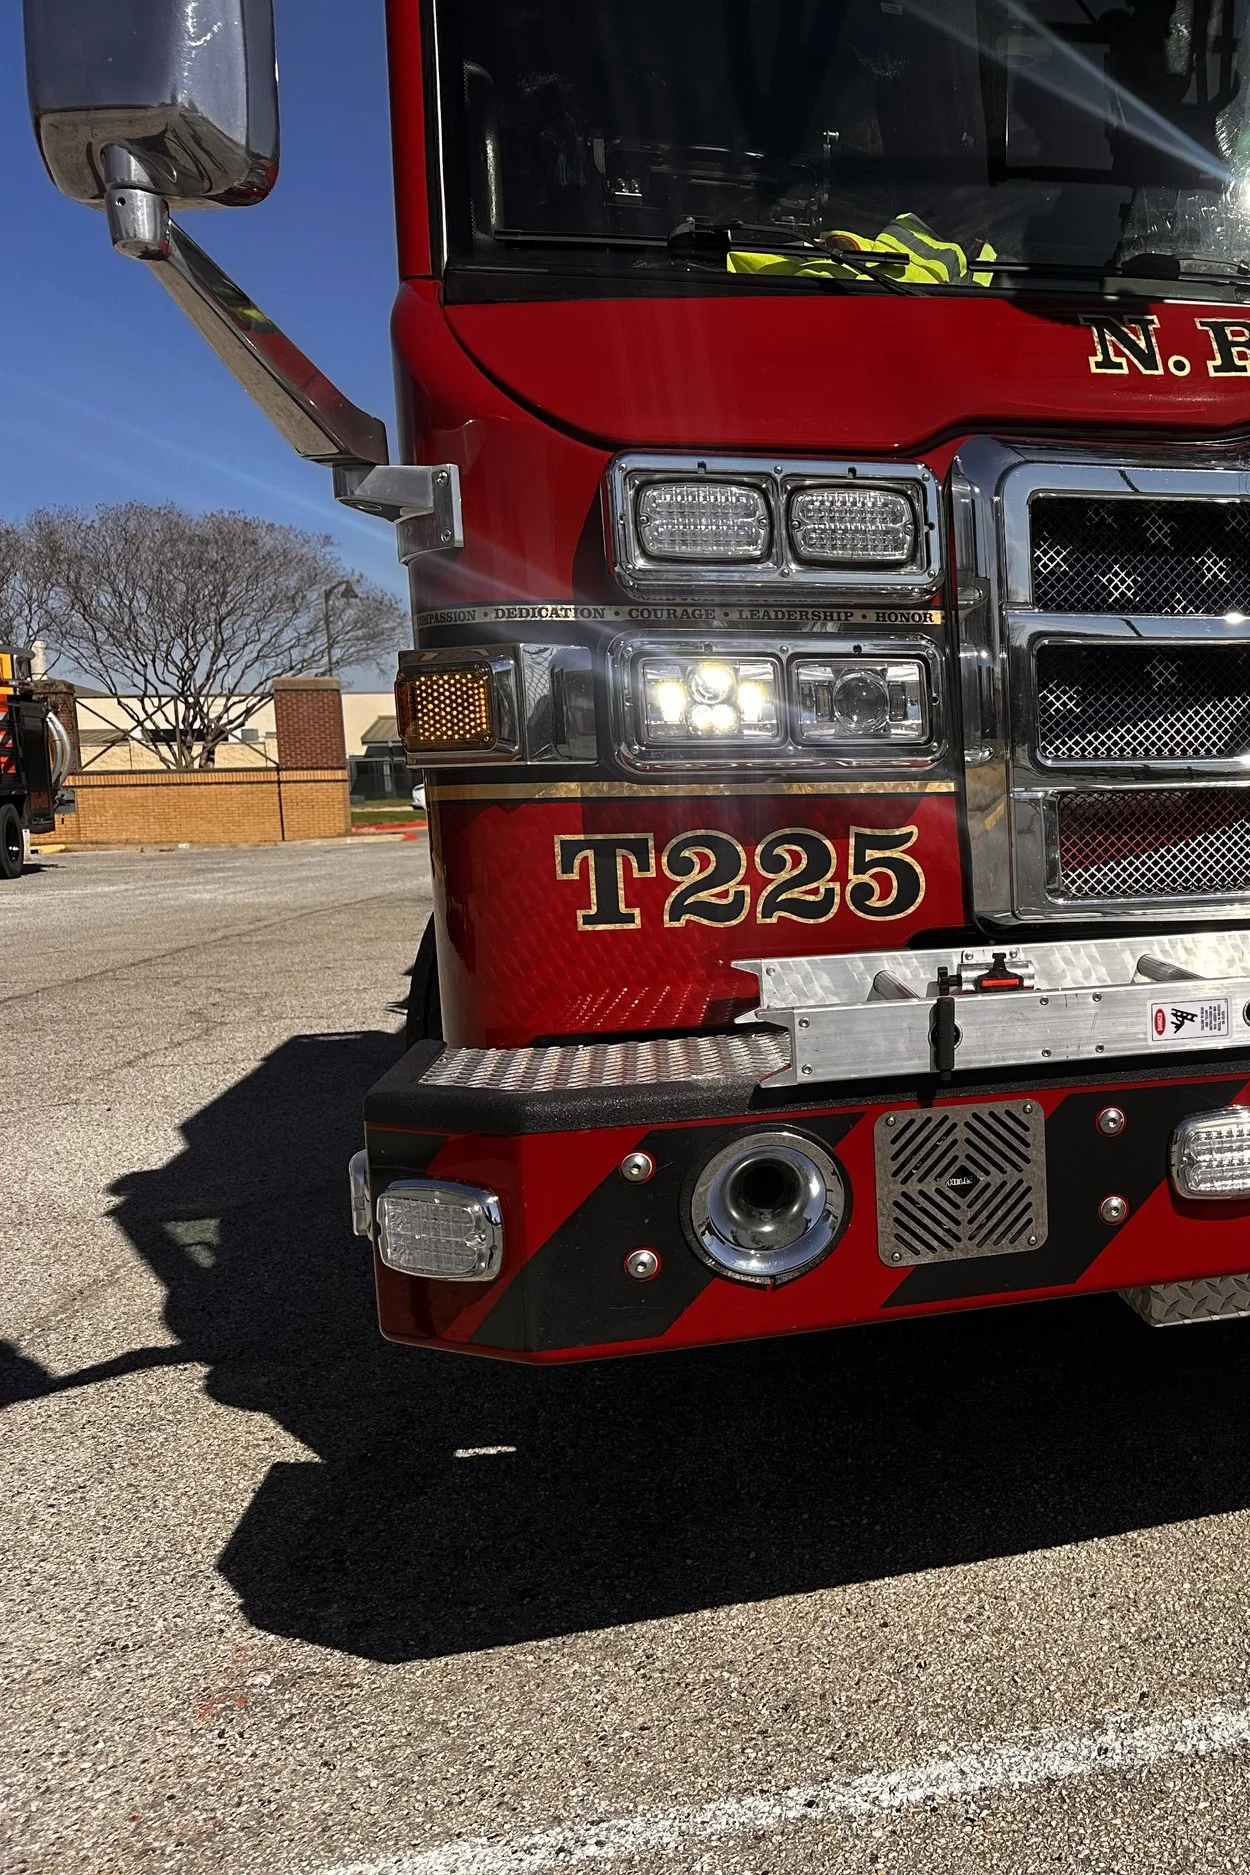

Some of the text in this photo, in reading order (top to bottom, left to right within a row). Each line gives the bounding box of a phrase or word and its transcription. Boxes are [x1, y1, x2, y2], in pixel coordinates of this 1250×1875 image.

[416, 606, 935, 627] COMPASSION DEDICATION COURAGE LEADERSHIP HONOR
[554, 824, 926, 931] T225
